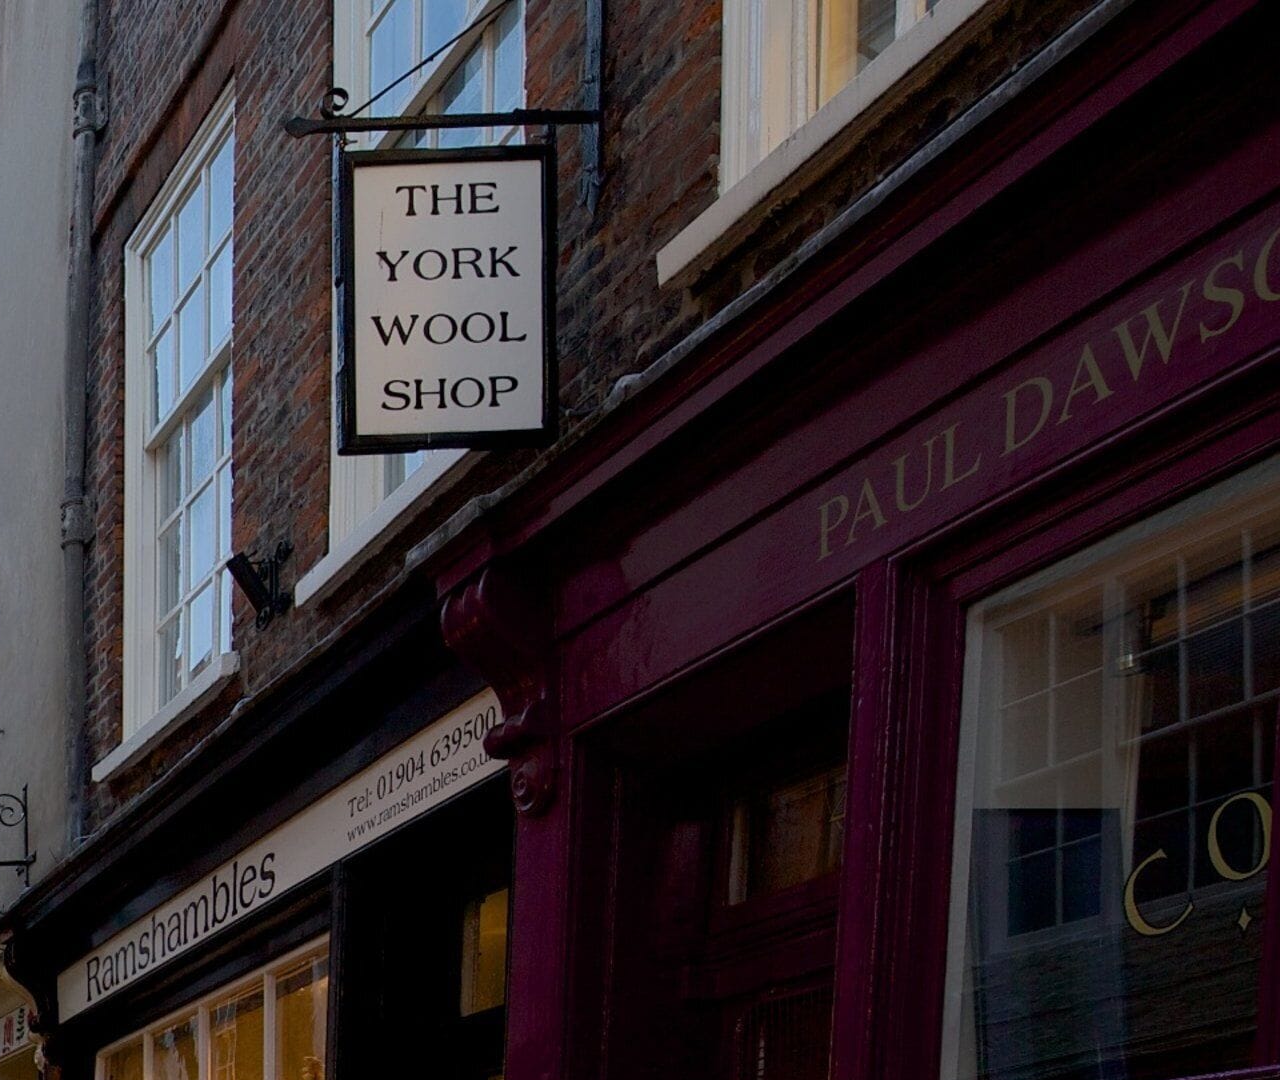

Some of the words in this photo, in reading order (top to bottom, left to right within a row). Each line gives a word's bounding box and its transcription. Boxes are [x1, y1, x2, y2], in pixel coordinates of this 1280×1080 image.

[395, 182, 500, 216] THE
[376, 245, 520, 282] YORK
[371, 311, 527, 346] WOOL
[381, 375, 518, 411] SHOP
[816, 421, 982, 562] PAUL
[347, 787, 372, 818] Tel:
[376, 751, 425, 800] 01904
[430, 705, 497, 767] 639500
[347, 752, 491, 842] www.ramshambles.co.u
[86, 851, 276, 1003] Ramshambles
